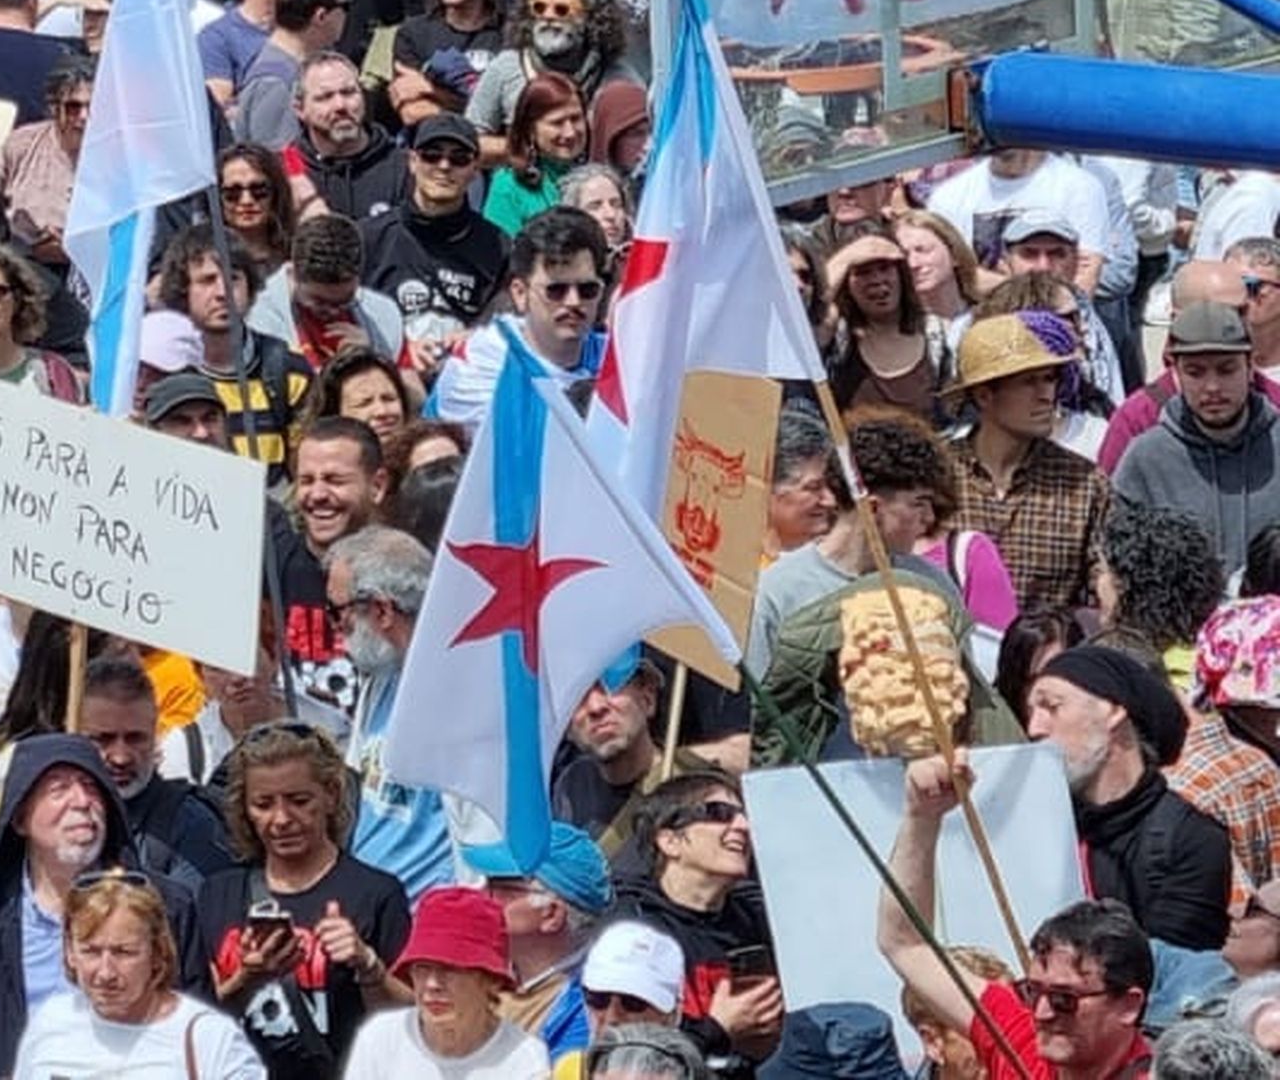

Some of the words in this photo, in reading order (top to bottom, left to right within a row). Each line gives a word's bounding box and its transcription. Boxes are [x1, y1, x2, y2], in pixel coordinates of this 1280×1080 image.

[24, 426, 91, 487] PARA
[108, 465, 130, 497] A
[0, 481, 59, 524] NON
[76, 504, 150, 565] PARA
